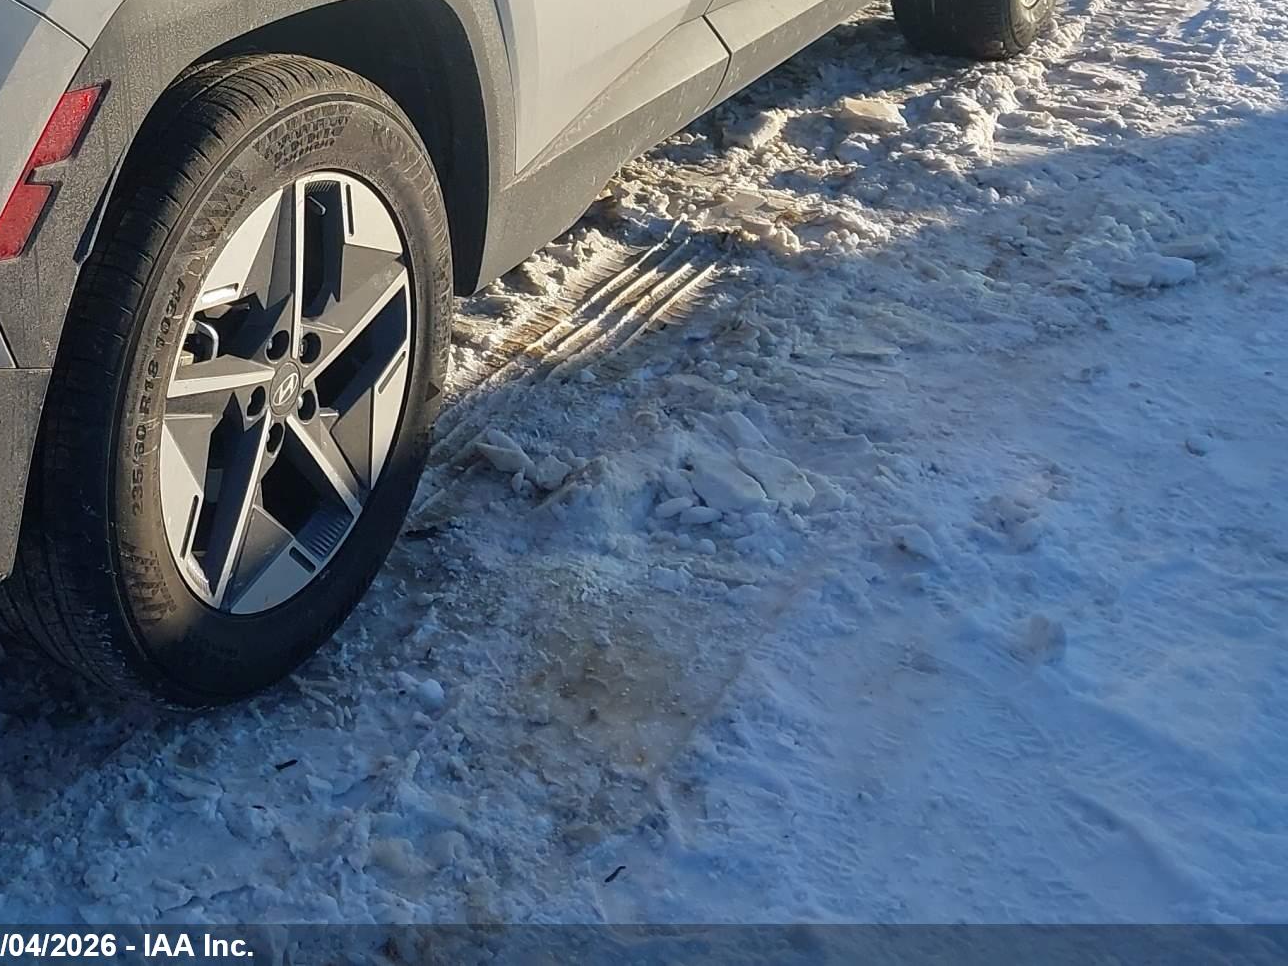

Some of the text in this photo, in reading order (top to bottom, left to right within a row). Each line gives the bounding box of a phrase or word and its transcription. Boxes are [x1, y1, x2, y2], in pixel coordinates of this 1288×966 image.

[130, 423, 148, 517] 235/60
[139, 359, 160, 415] R18
[156, 278, 185, 348] 103H
